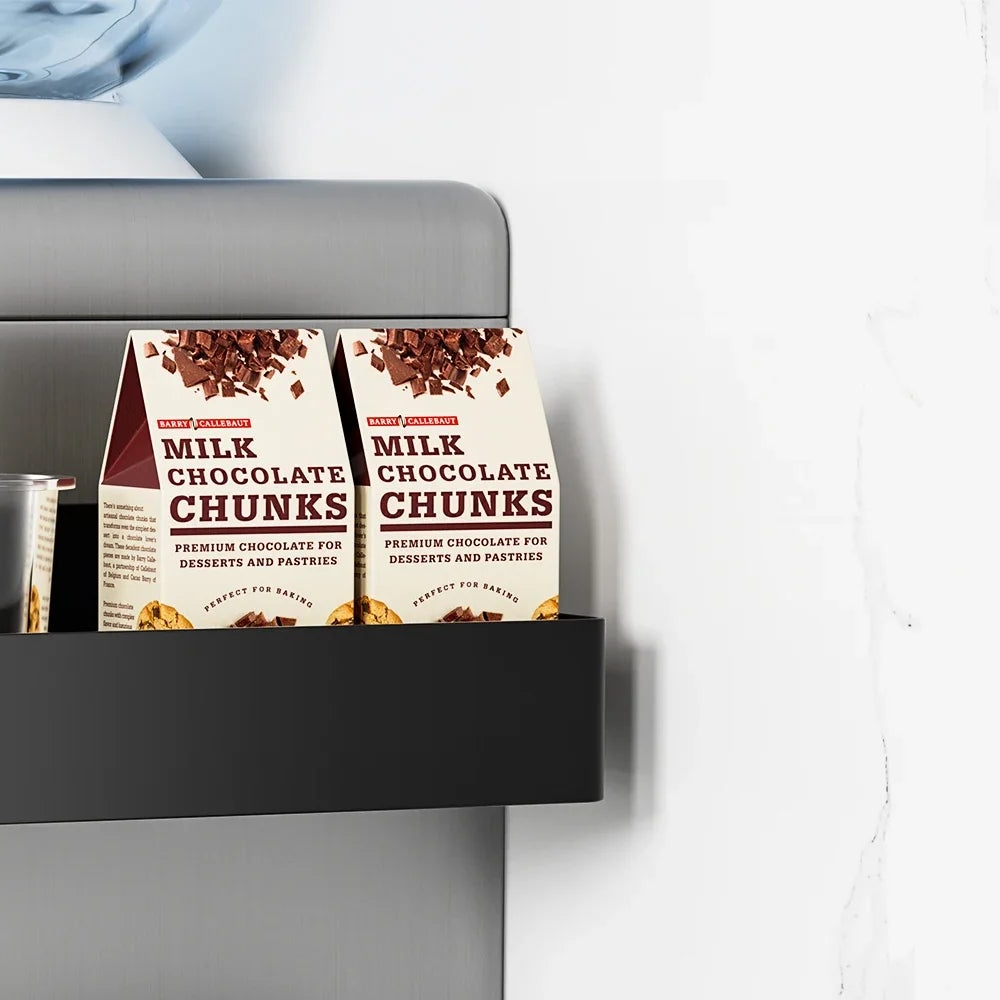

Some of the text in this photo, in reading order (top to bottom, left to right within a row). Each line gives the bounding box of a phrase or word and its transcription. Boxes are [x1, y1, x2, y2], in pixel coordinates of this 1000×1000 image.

[159, 419, 249, 428] BARRY CALLEBAUT
[368, 417, 457, 426] BARRY CALLEBAUT
[160, 437, 258, 460] MILK
[370, 434, 465, 457] MILK
[167, 466, 346, 487] CHOCOLATE
[377, 462, 552, 483] CHOCOLATE
[169, 492, 348, 523] CHUNKS
[379, 488, 553, 520] CHUNKS
[174, 540, 343, 553] PREMIUM CHOCOLATE FOR
[384, 536, 548, 549] PREMIUM CHOCOLATE FOR
[179, 556, 338, 569] DESSERTS AND PASTRIES
[389, 551, 544, 564] DESSERTS AND PASTRIES
[204, 587, 250, 613] PERFECT
[275, 587, 314, 609] BAKING
[412, 582, 458, 608] PERFECT
[482, 583, 520, 605] BAKING
